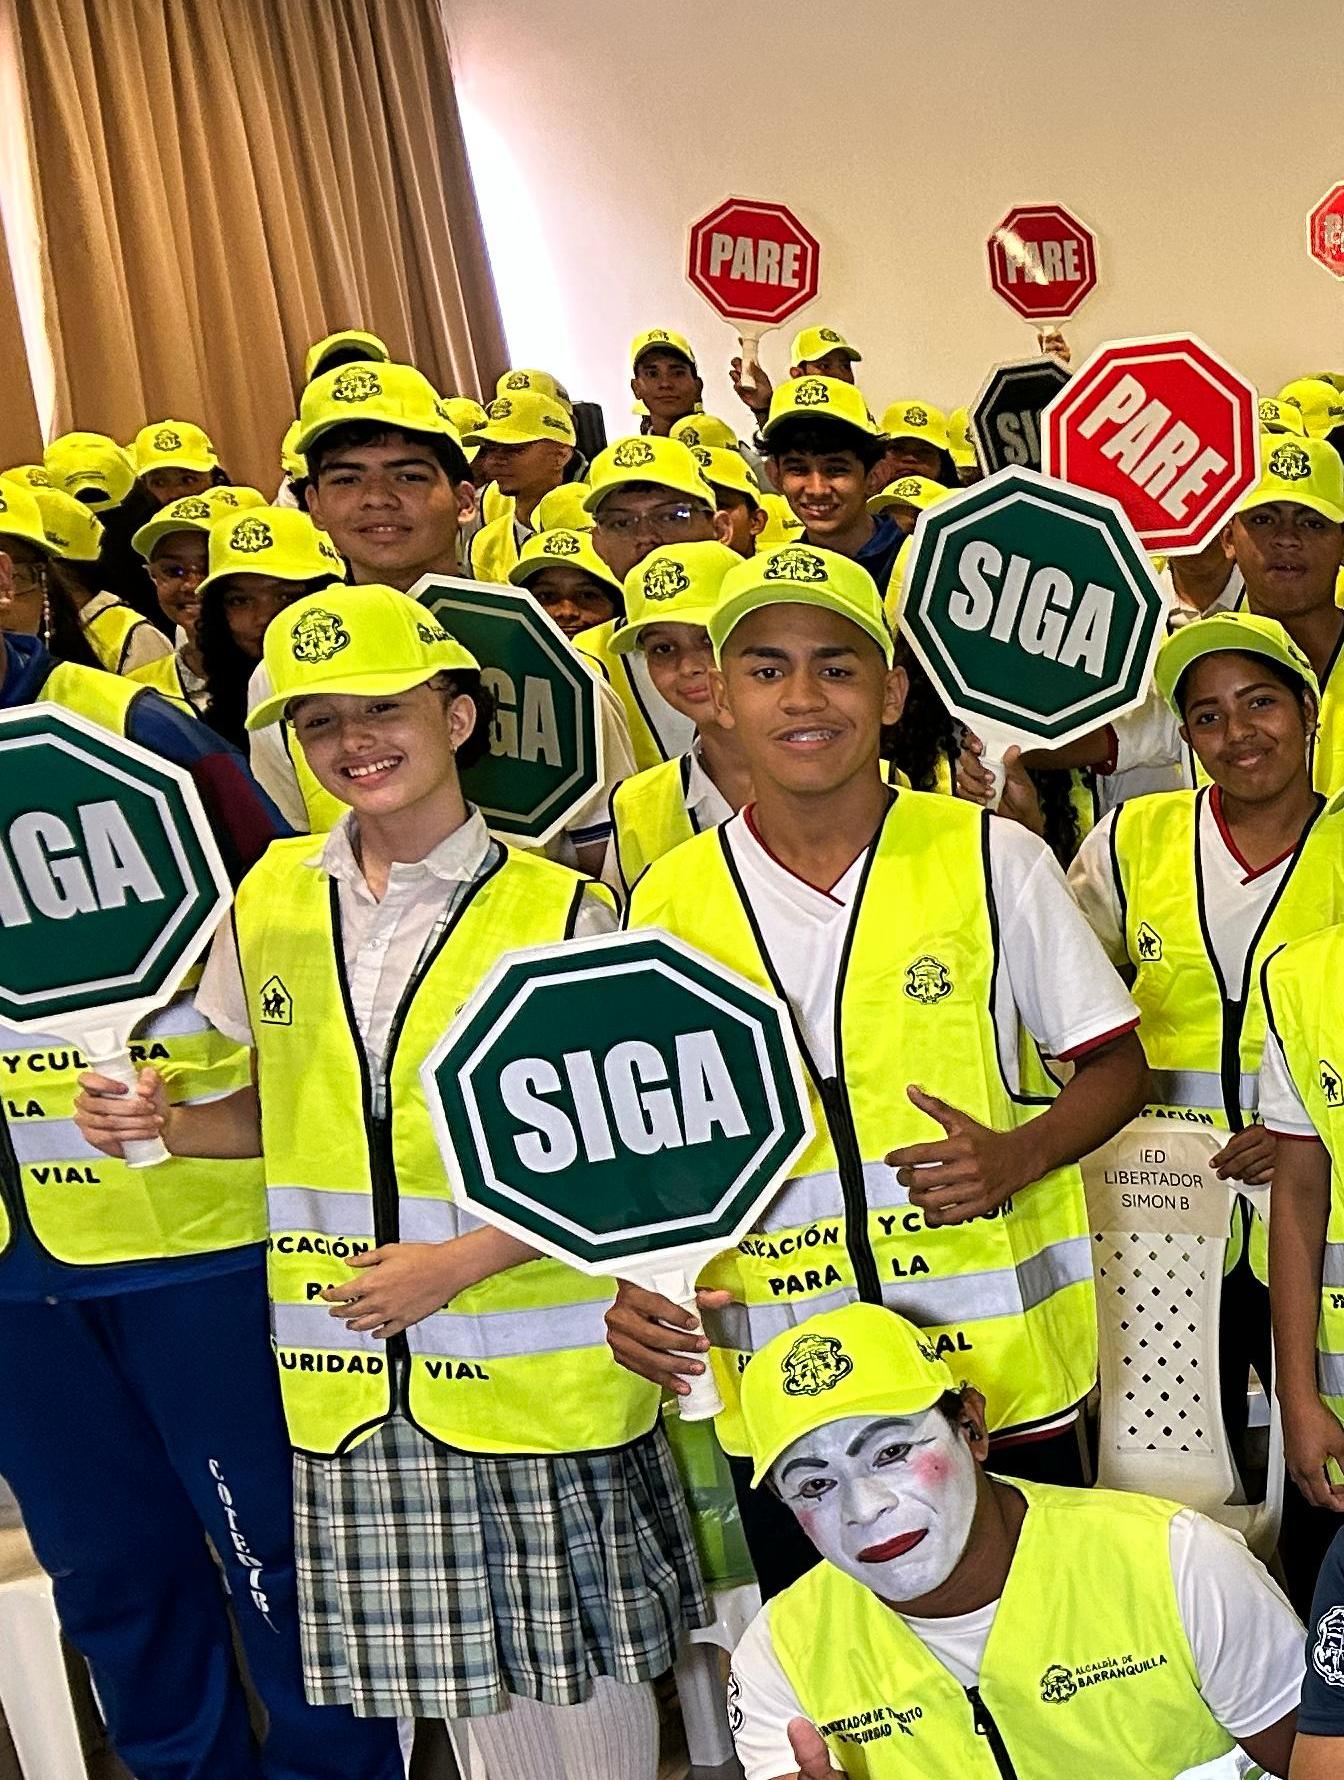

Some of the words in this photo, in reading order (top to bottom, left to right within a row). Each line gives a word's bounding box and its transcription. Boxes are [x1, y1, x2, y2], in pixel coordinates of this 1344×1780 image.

[708, 232, 801, 288] PARE
[996, 409, 1041, 466] SI
[1077, 374, 1228, 522] PARE
[950, 539, 1116, 678] SIGA
[480, 667, 563, 767] GA
[0, 800, 165, 928] IGA
[27, 1043, 170, 1073] CULRA
[7, 1100, 45, 1118] LA
[500, 1029, 752, 1175] SIGA
[1140, 1149, 1166, 1164] IED
[30, 1167, 101, 1185] VIAL
[1104, 1171, 1204, 1189] LIBERTADOR
[1121, 1193, 1176, 1210] SIMON
[1180, 1196, 1190, 1210] B
[768, 1264, 842, 1296] PARA
[891, 1254, 929, 1277] LA
[279, 1352, 384, 1375] URIDAD
[424, 1360, 490, 1380] VIAL
[1078, 1654, 1168, 1688] BARRANQUILLA
[1122, 1654, 1133, 1665] DE
